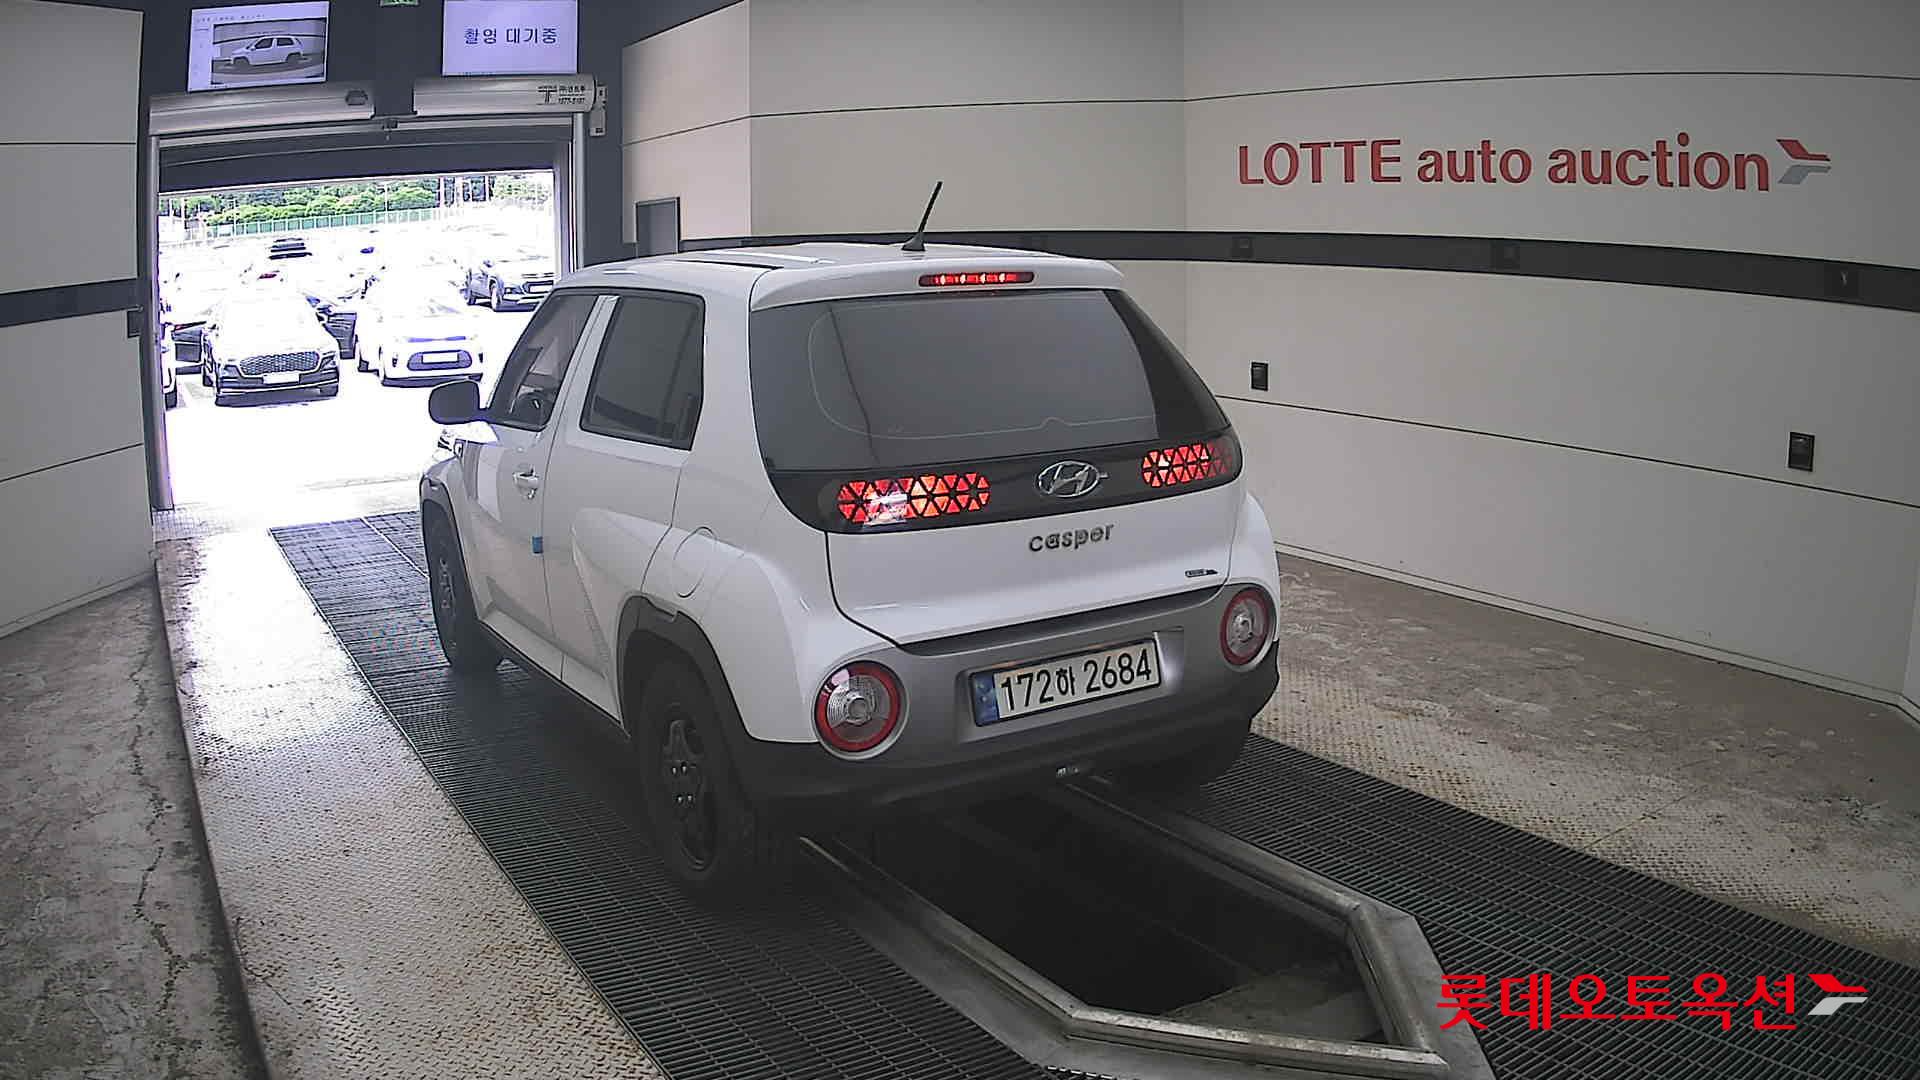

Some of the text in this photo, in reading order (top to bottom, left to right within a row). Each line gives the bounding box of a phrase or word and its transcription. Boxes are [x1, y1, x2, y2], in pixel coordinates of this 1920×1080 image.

[464, 28, 557, 44] 촬영 대기중
[1238, 131, 1769, 191] LOTTE auto auction
[1029, 524, 1114, 552] casper
[1001, 649, 1151, 711] 172하 2684
